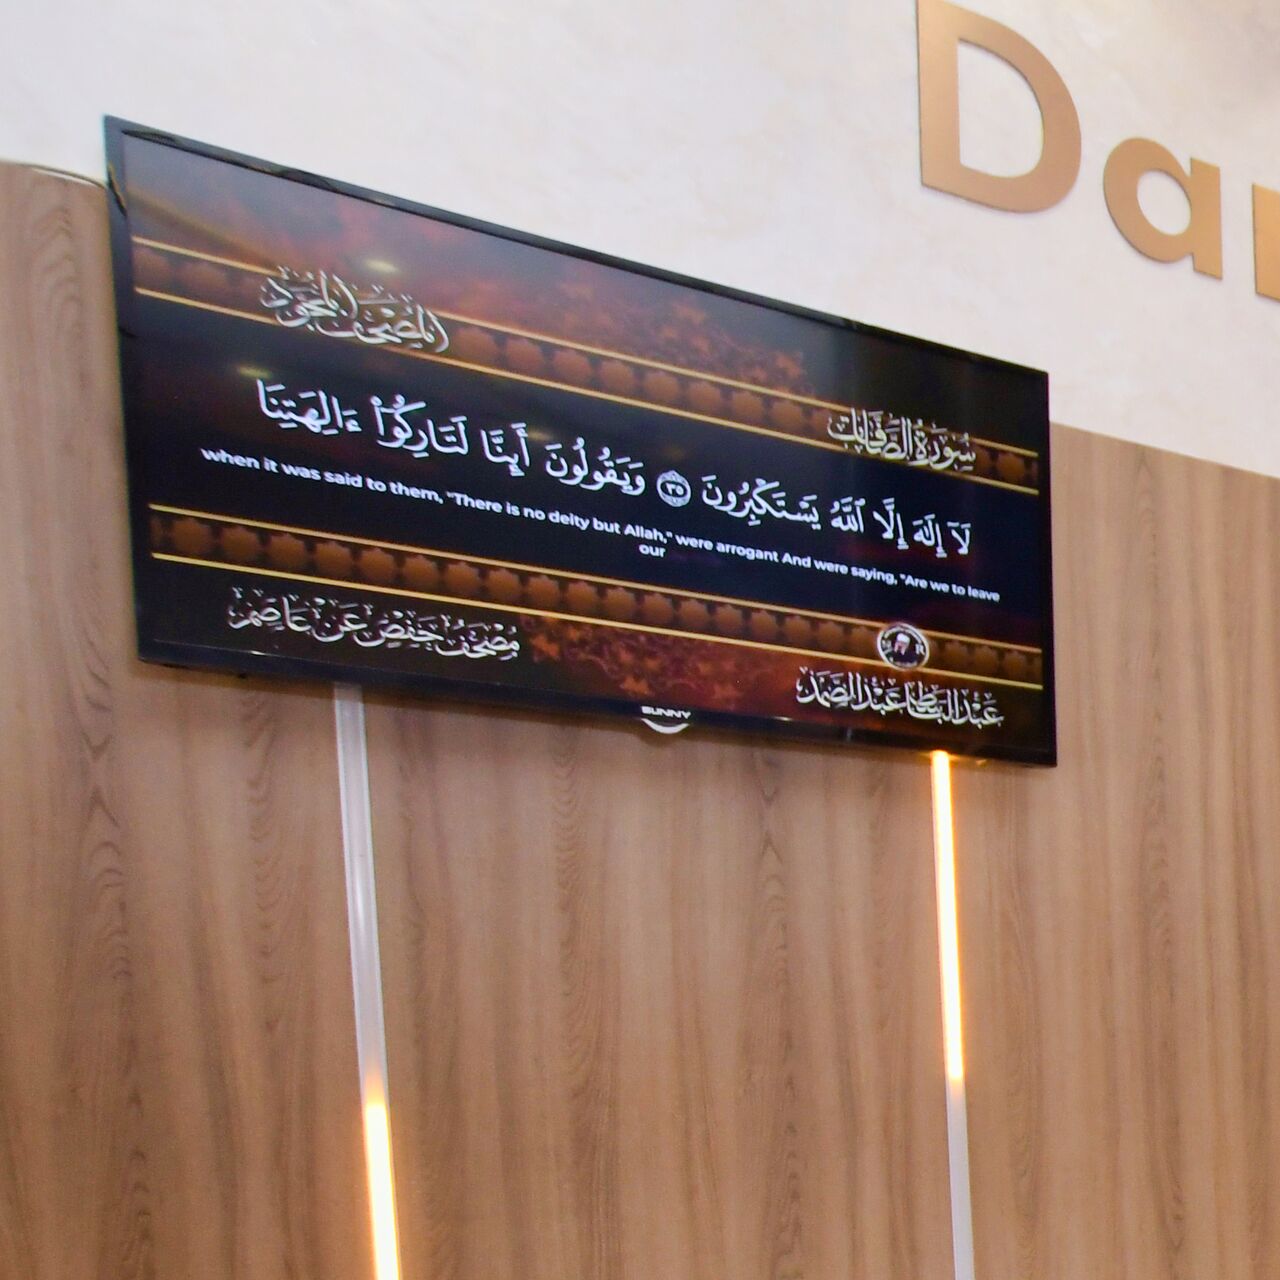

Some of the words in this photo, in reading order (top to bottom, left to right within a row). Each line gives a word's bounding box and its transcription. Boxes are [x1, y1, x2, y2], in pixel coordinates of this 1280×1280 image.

[200, 447, 261, 470] when
[263, 456, 278, 474] it
[281, 462, 322, 481] was
[323, 470, 363, 489] said
[365, 477, 387, 493] to
[389, 480, 444, 505] them,
[446, 491, 503, 515] "There
[505, 501, 520, 518] is
[522, 507, 546, 522] no
[548, 510, 590, 532] deity
[592, 517, 621, 535] but
[624, 523, 673, 545] Allah,"
[675, 532, 714, 552] were
[716, 541, 780, 564] arrogant
[781, 550, 812, 569] And
[814, 558, 849, 576] were
[851, 565, 898, 586] saying,
[900, 574, 928, 590] "Are
[929, 581, 950, 594] we
[951, 582, 968, 596] to
[968, 586, 1000, 602] leave
[638, 544, 666, 559] our
